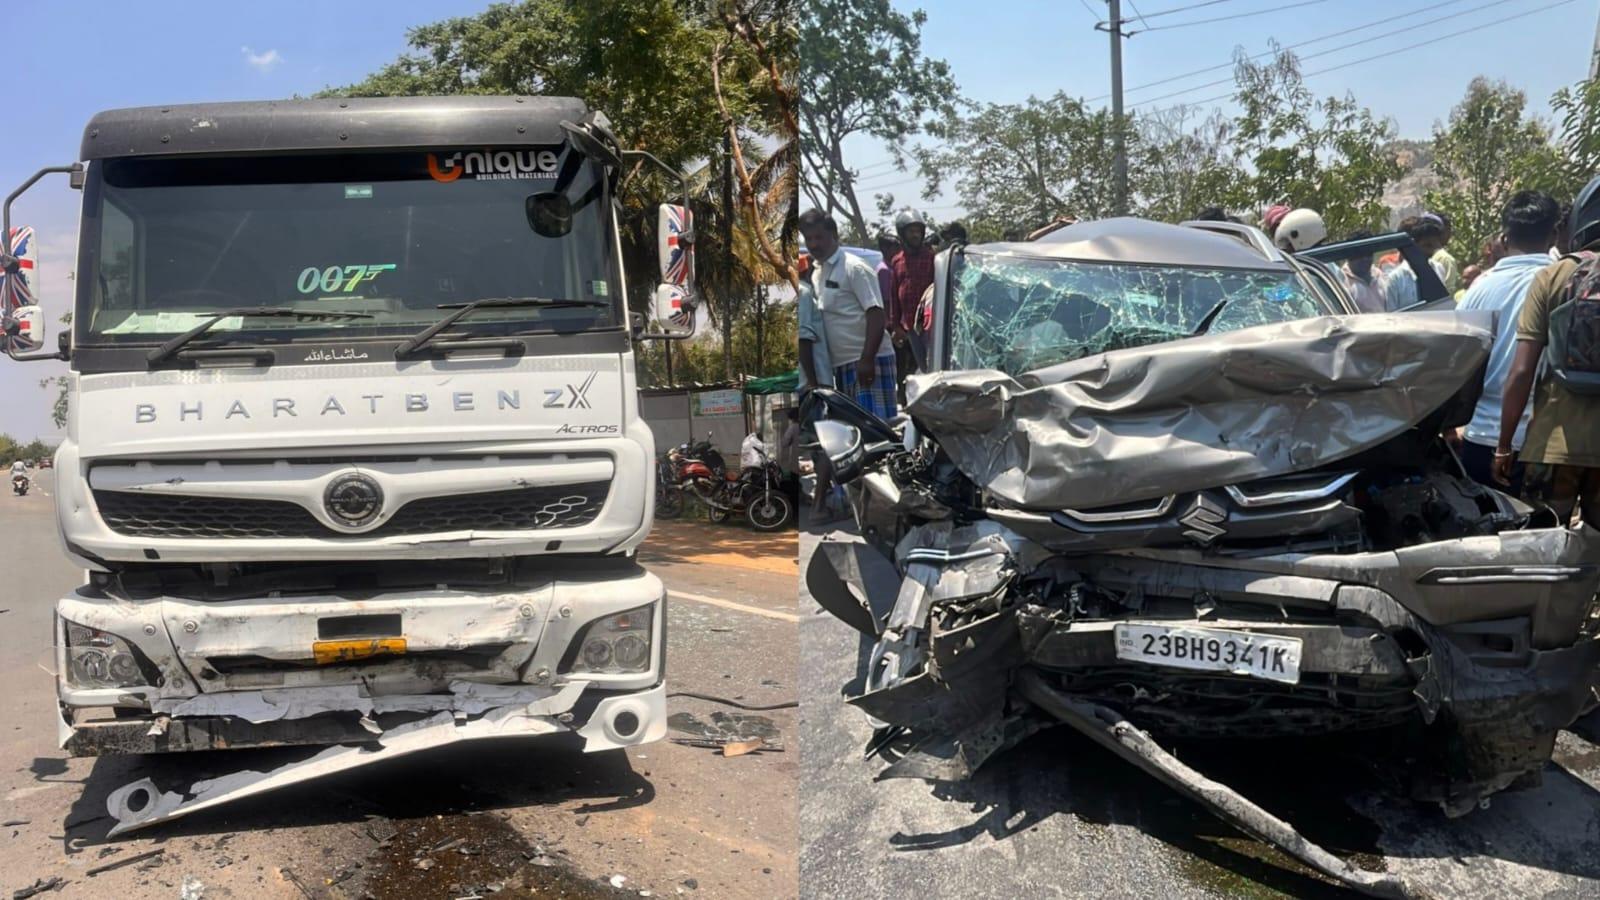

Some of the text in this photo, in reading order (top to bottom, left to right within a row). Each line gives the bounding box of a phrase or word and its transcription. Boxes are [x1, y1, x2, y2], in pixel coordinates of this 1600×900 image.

[475, 172, 559, 181] BUILDING MATERIALS
[297, 264, 394, 293] 007
[1142, 634, 1287, 674] 23BH9341K
